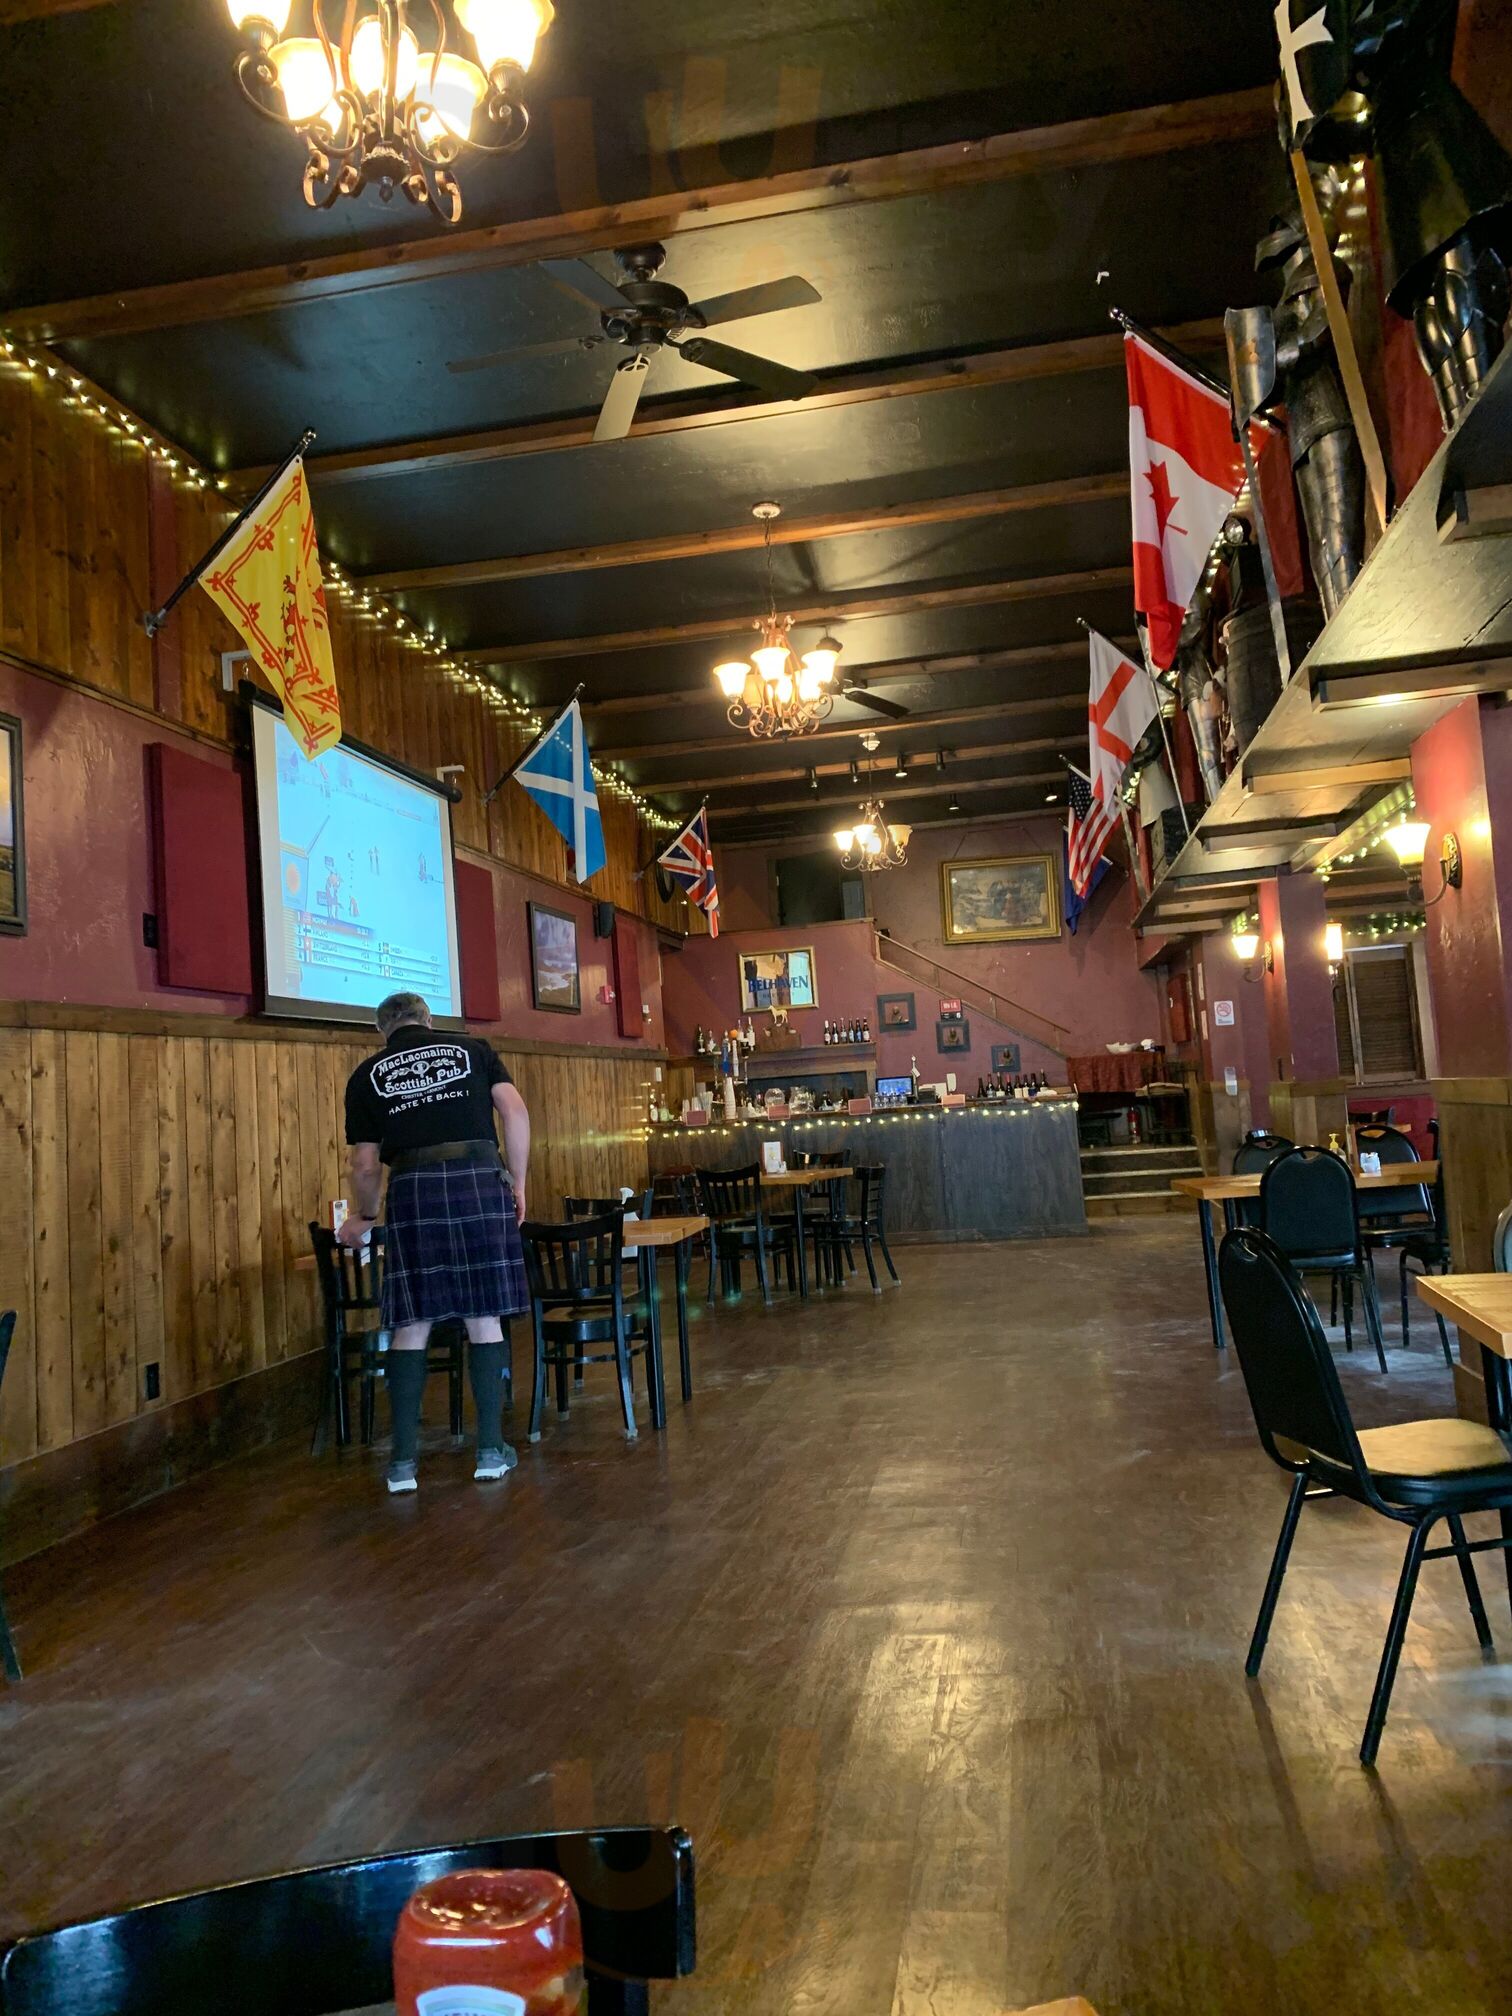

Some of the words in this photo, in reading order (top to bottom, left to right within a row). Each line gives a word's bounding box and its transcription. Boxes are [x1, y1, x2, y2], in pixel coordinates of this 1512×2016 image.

[748, 975, 809, 993] BELHAVEN
[377, 1047, 463, 1077] MacLaomainn's
[384, 1075, 434, 1093] Scottish
[436, 1065, 461, 1082] Pub
[388, 1100, 419, 1116] HASTE
[421, 1095, 433, 1104] YE
[436, 1090, 463, 1101] BACK
